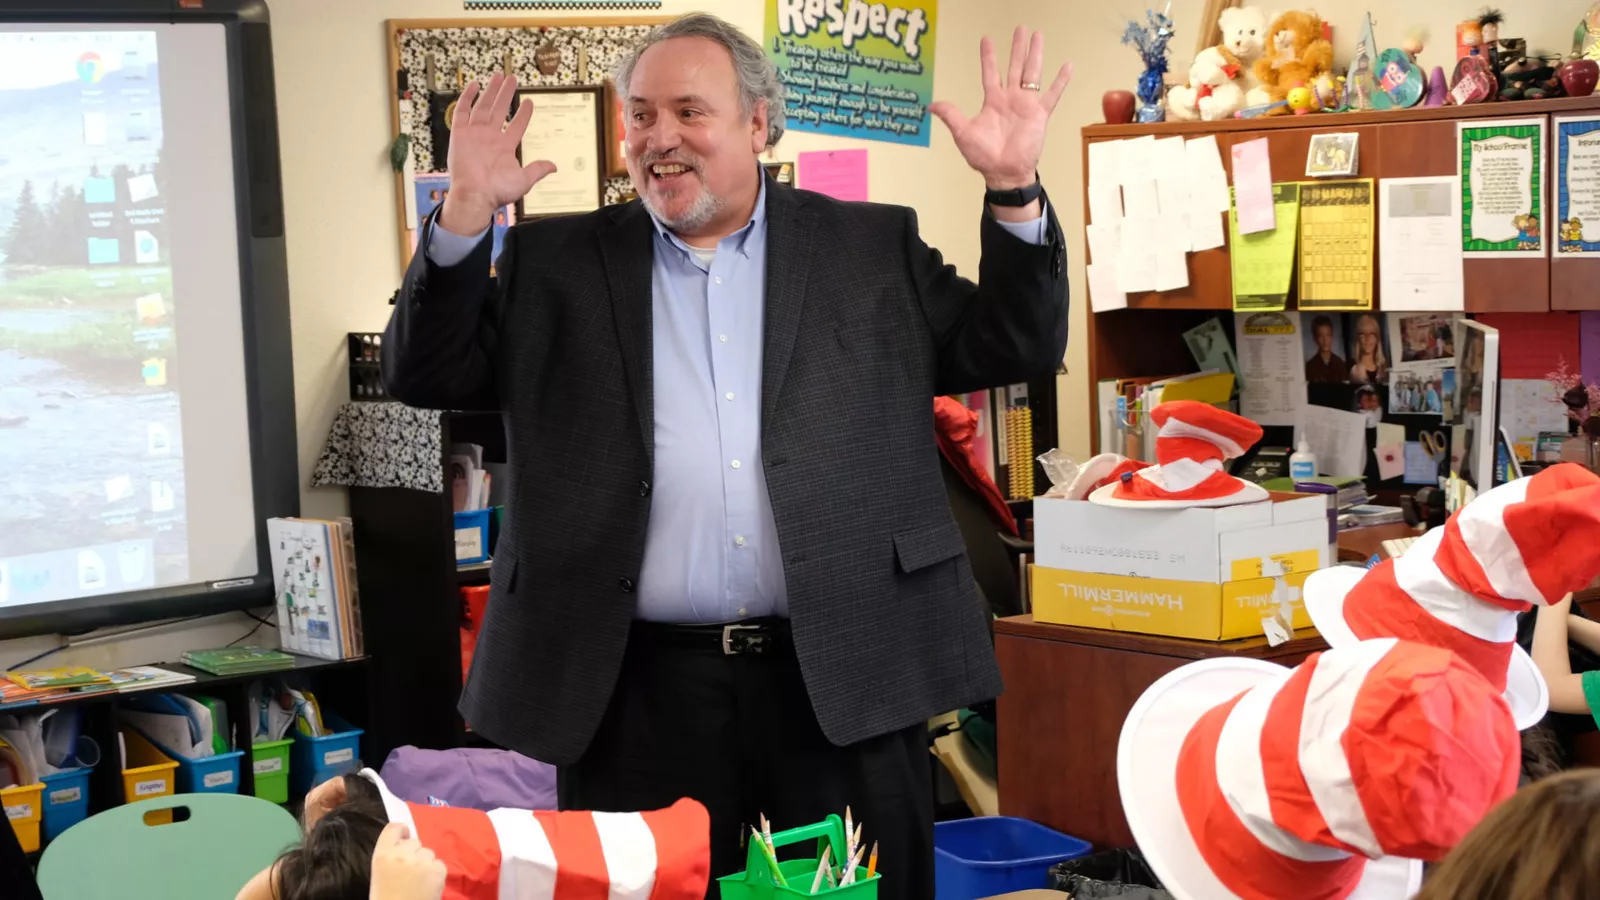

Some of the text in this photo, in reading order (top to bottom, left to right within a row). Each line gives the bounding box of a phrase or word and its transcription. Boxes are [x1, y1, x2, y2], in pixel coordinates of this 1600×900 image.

[778, 0, 928, 60] Respect
[784, 39, 819, 61] Treating
[819, 47, 849, 65] others
[849, 50, 863, 66] the
[864, 56, 883, 73] way
[881, 60, 900, 74] you
[900, 60, 923, 76] want
[790, 56, 849, 79] to be treated
[817, 74, 851, 94] kindness
[849, 81, 869, 97] and
[867, 84, 919, 104] consideration
[803, 91, 840, 115] yourself
[839, 97, 869, 117] enough
[868, 101, 880, 113] to
[880, 98, 892, 115] be
[890, 103, 926, 122] yourself
[819, 109, 849, 127] others
[848, 112, 864, 129] for
[864, 113, 884, 129] who
[883, 114, 904, 136] they
[901, 123, 919, 136] are
